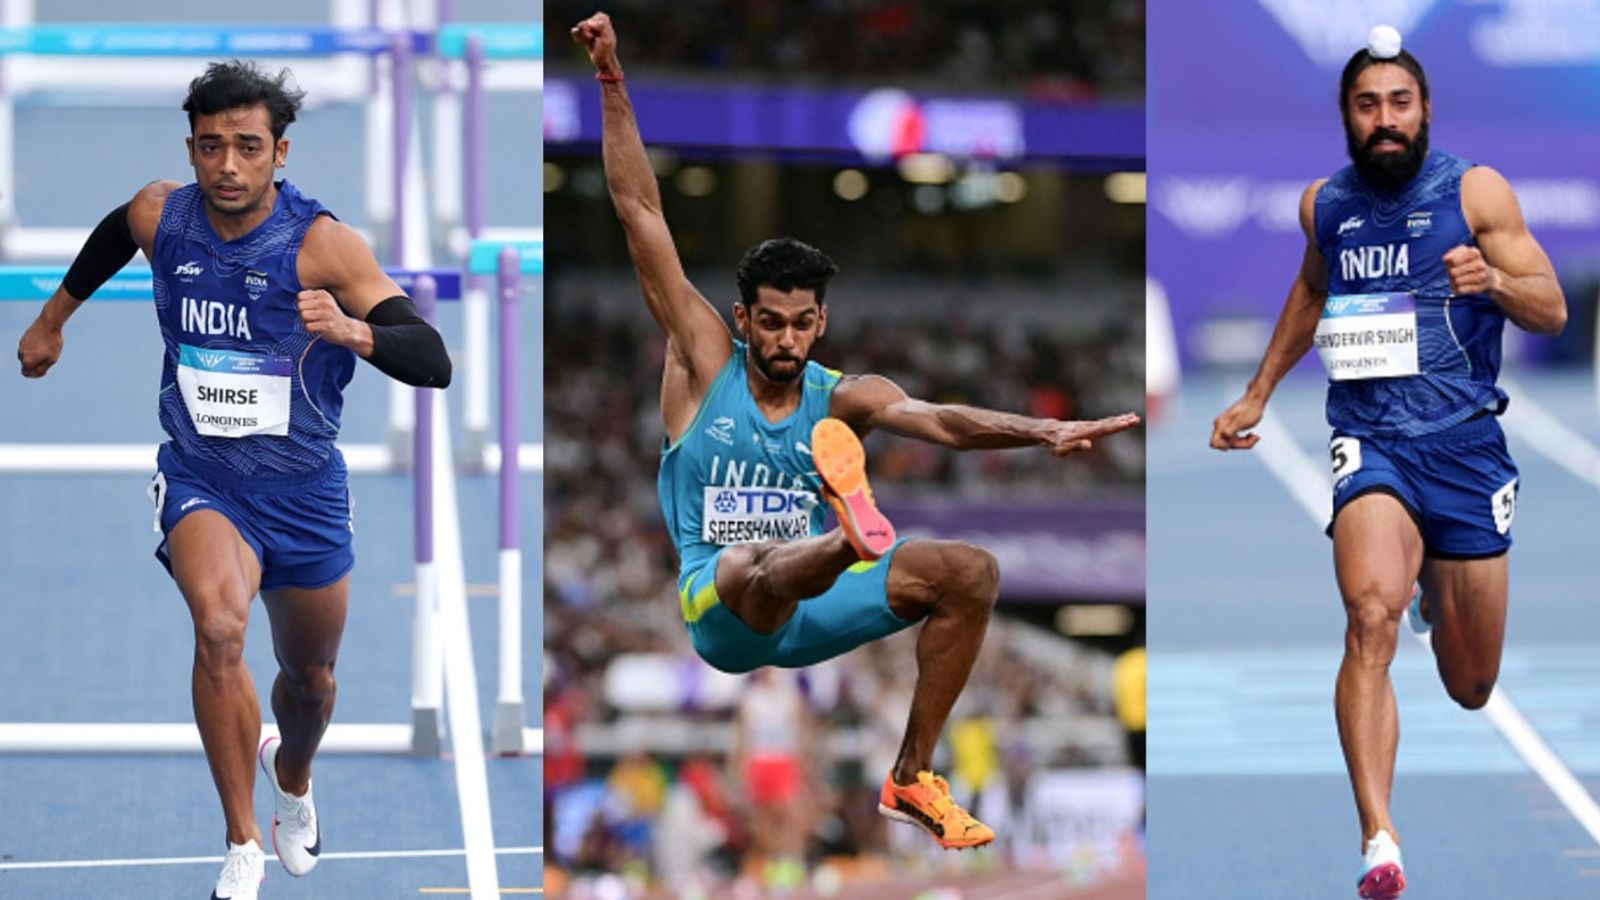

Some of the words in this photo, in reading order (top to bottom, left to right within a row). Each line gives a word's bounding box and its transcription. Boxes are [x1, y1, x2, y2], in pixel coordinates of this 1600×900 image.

[1340, 243, 1409, 281] INDIA
[181, 297, 252, 341] INDIA
[1376, 328, 1413, 345] SINGH
[197, 385, 258, 405] SHIRSE
[196, 413, 258, 427] LONGINES
[737, 491, 808, 514] TDK
[709, 517, 807, 543] SREESHANKAR
